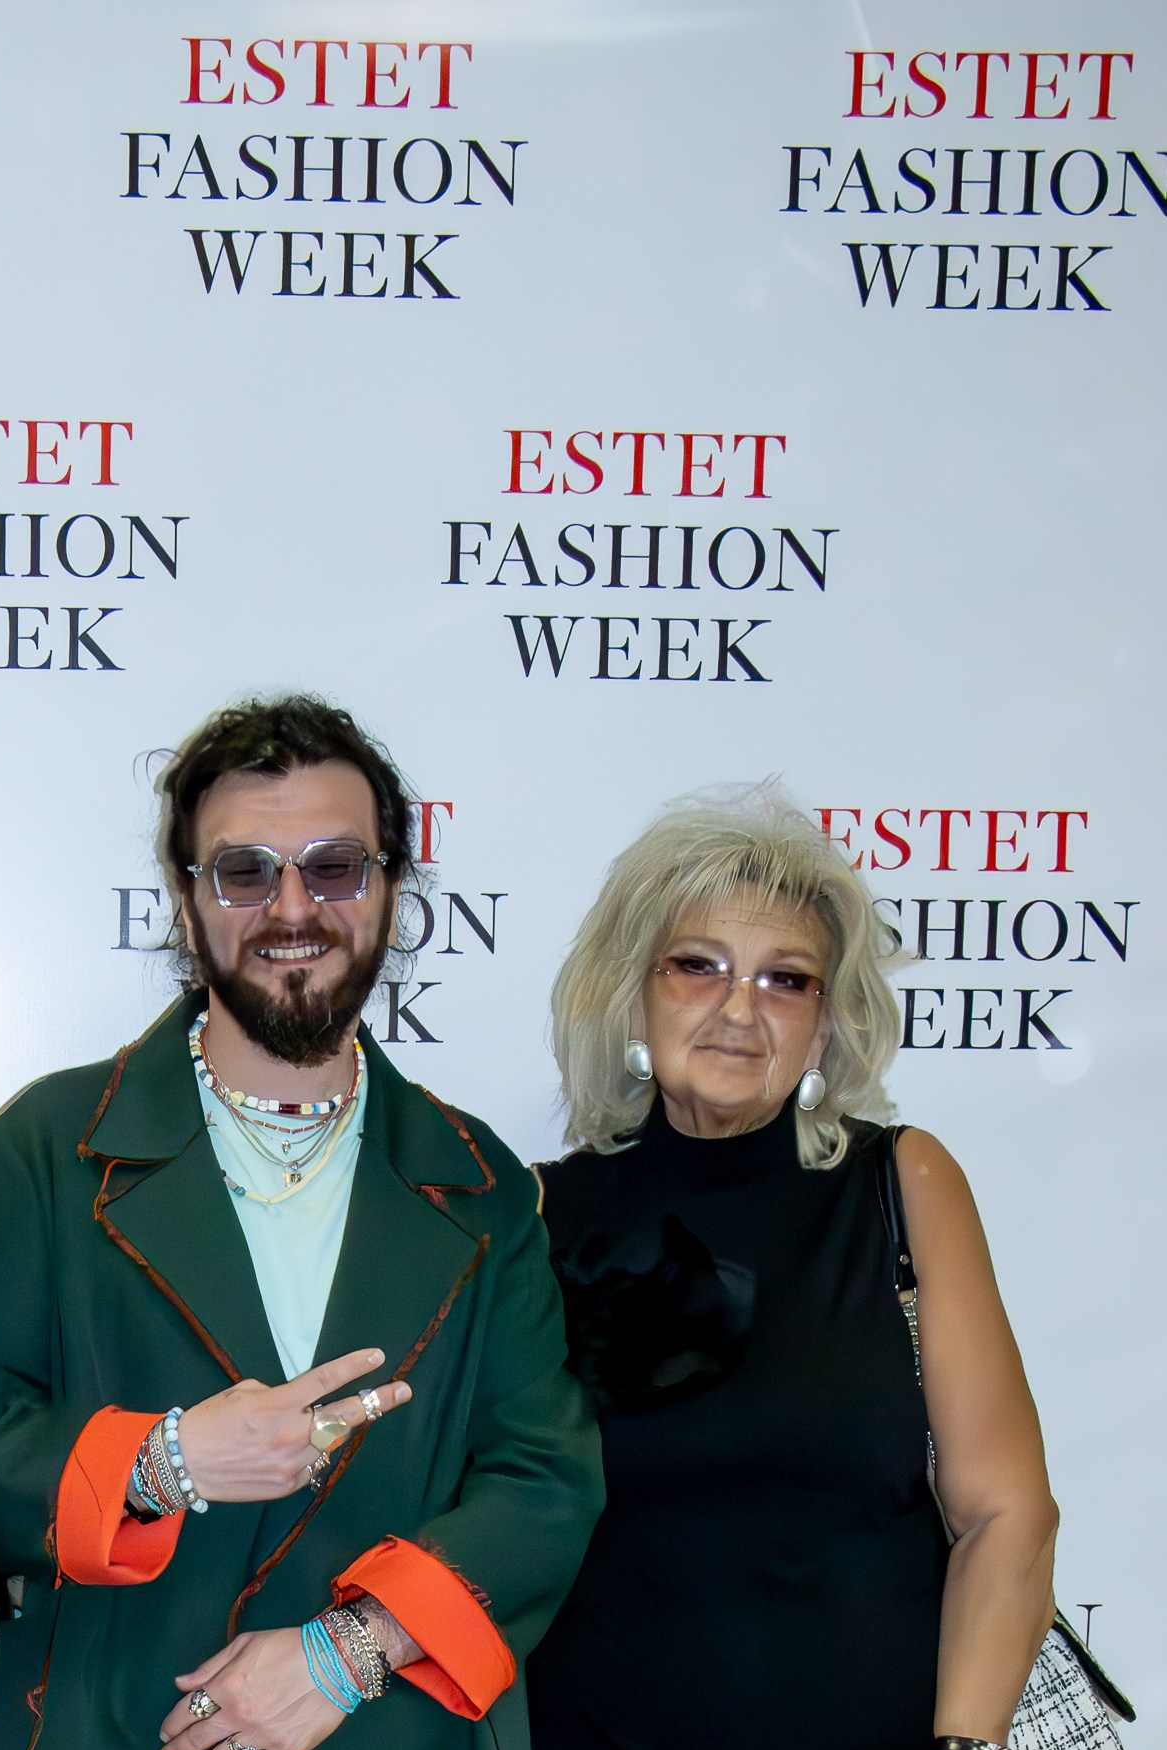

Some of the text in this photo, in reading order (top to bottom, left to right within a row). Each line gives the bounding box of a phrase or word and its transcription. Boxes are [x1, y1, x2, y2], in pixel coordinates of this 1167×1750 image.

[180, 38, 472, 109] ESTET
[842, 52, 1133, 120] ESTET
[120, 133, 528, 206] FASHION
[779, 147, 1167, 217] FASHION
[184, 229, 460, 299] WEEK
[842, 243, 1113, 311] WEEK
[502, 431, 786, 498] ESTET
[441, 522, 840, 592] FASHION
[504, 615, 772, 682] WEEK
[897, 988, 1073, 1050] EEK
